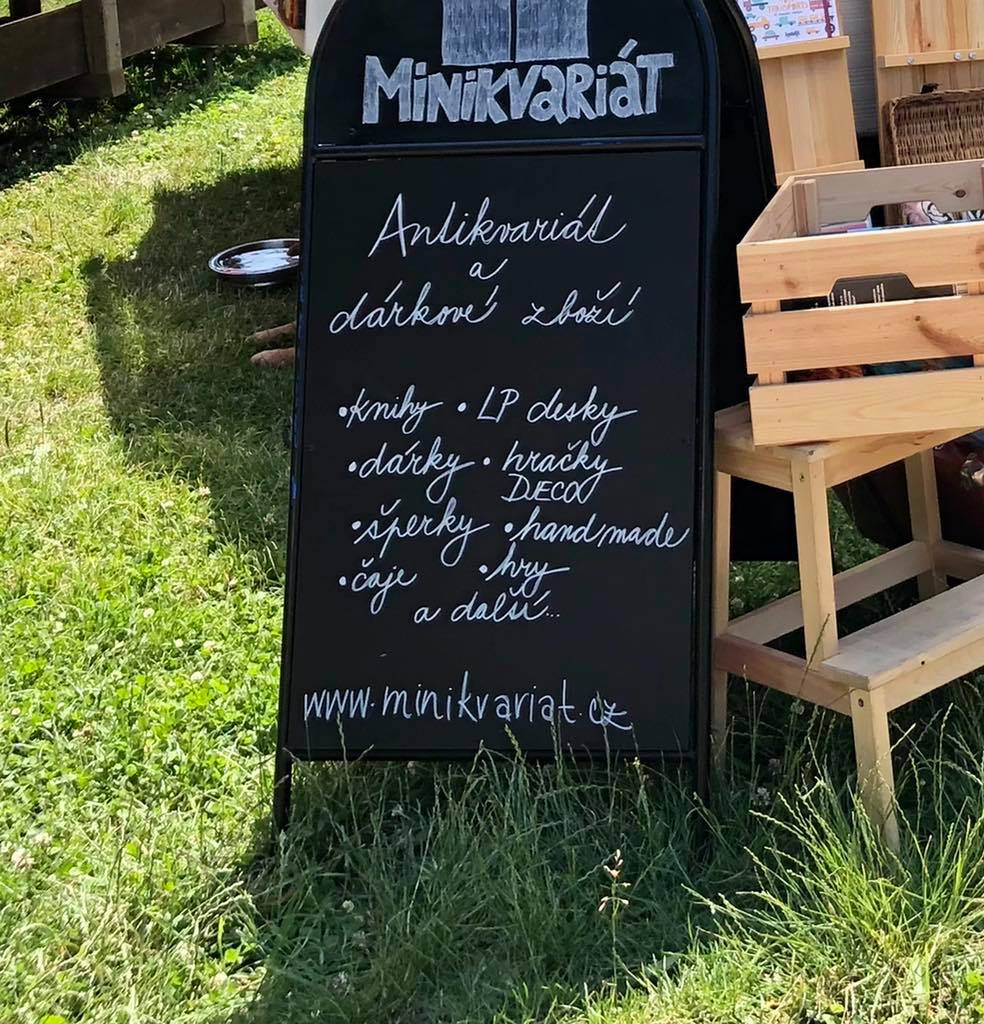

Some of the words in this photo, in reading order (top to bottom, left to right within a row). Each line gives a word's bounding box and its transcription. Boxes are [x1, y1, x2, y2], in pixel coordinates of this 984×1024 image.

[368, 193, 627, 257] Antikvariát
[468, 258, 508, 280] a
[329, 281, 500, 334] dárkové
[521, 281, 641, 326] zboží
[346, 385, 443, 434] knihy
[477, 386, 519, 423] LP
[526, 386, 638, 445] desky
[359, 437, 475, 504] dárky
[502, 439, 623, 502] hračky
[354, 497, 490, 567] šperky
[352, 557, 418, 615] čaje
[485, 542, 570, 599] hry
[413, 607, 442, 624] a
[304, 671, 633, 730] www.minikvariat.cz
